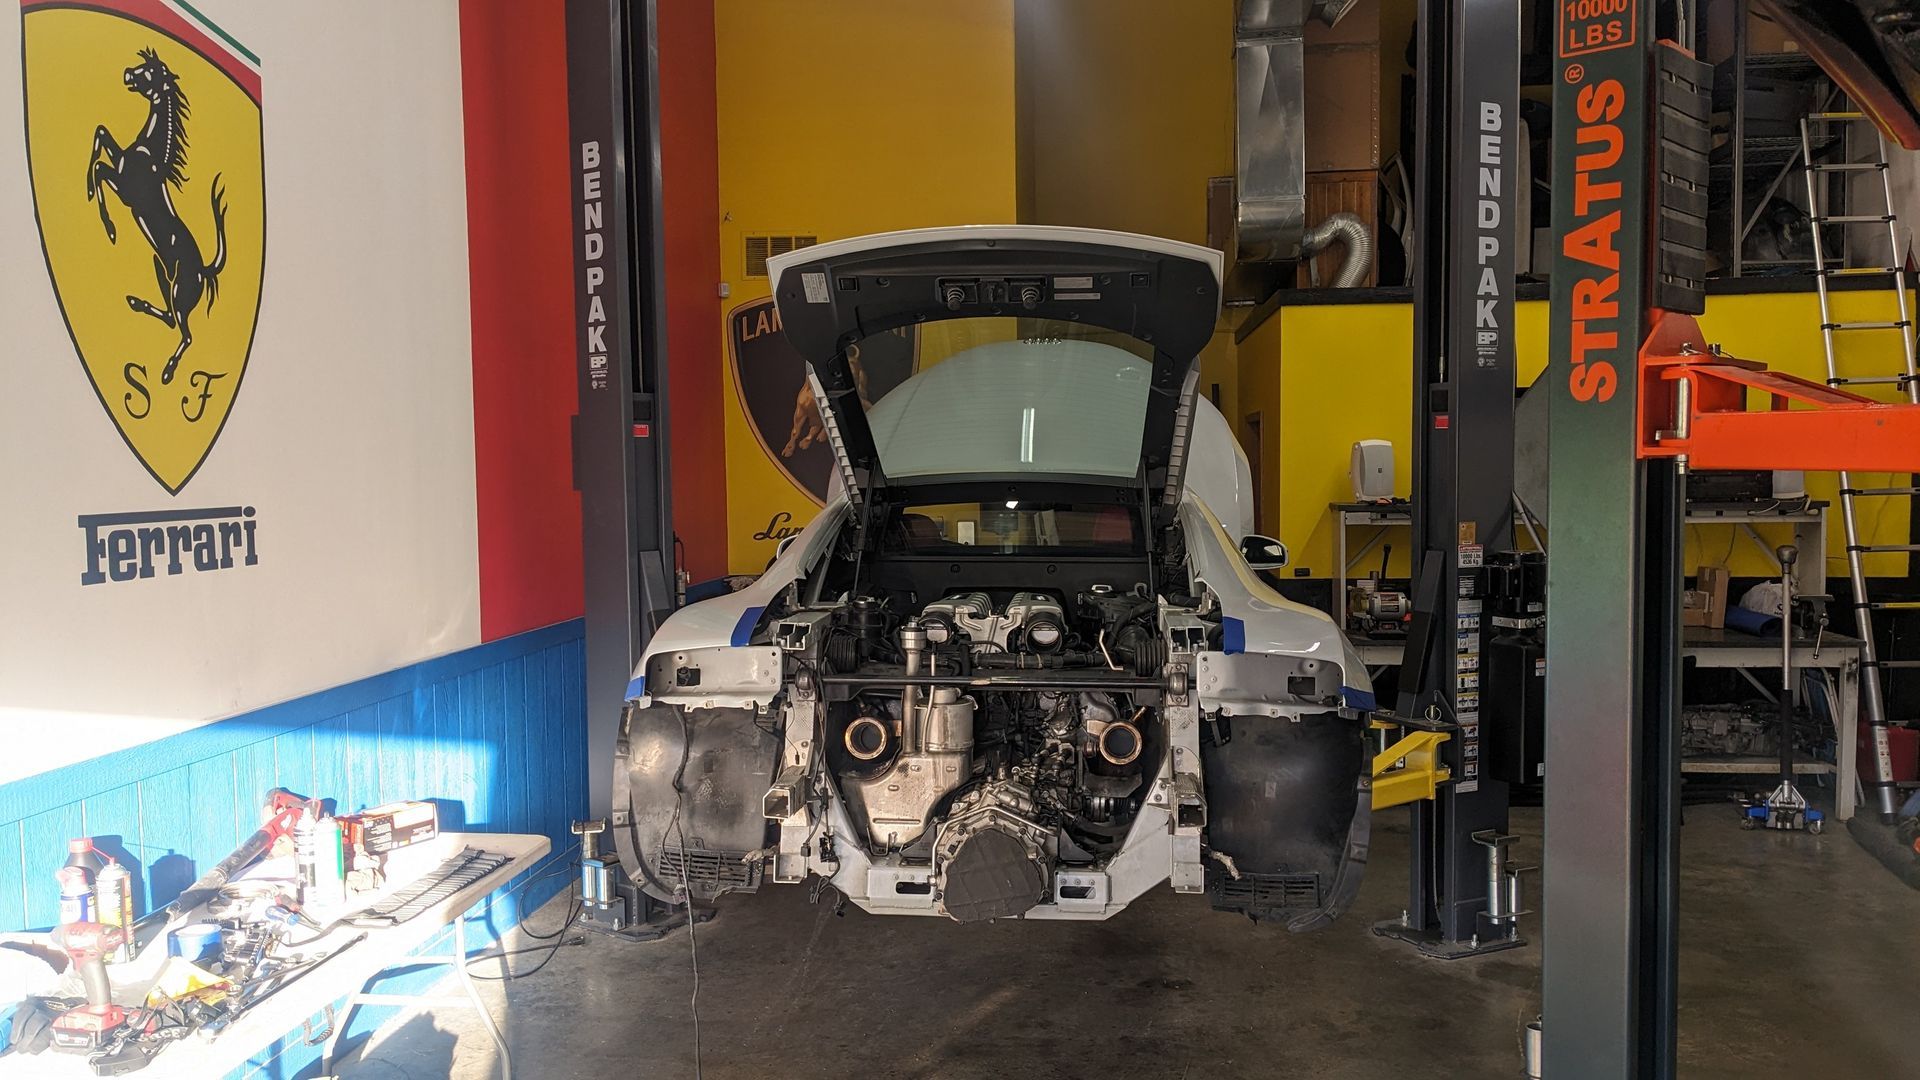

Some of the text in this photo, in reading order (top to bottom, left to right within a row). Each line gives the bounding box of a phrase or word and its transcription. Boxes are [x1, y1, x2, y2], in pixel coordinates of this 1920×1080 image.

[1566, 0, 1628, 21] 10000
[1569, 20, 1623, 49] LBS
[582, 141, 607, 353] BENDPAK
[1475, 101, 1502, 328] BENDPAK
[124, 362, 229, 423] S F
[78, 506, 258, 586] Ferrari
